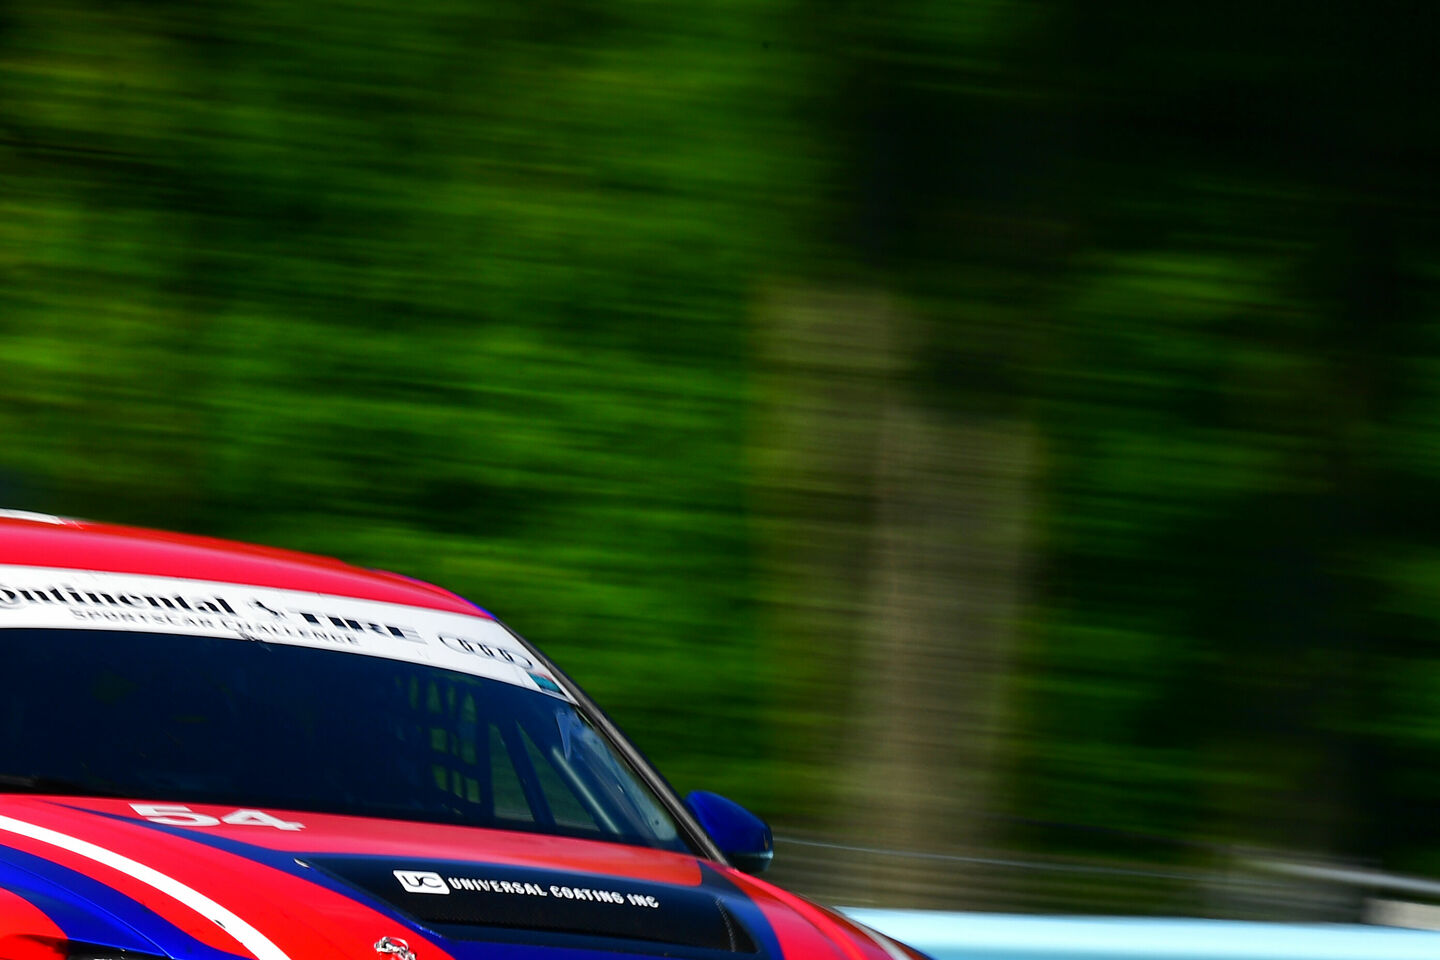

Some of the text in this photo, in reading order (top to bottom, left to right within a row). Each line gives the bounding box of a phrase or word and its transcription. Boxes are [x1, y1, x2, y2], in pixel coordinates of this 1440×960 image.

[289, 607, 427, 644] TIRE
[128, 803, 307, 831] 54
[448, 877, 548, 897] UNIVERSAL
[550, 885, 625, 904] COATING
[627, 893, 659, 908] INC
